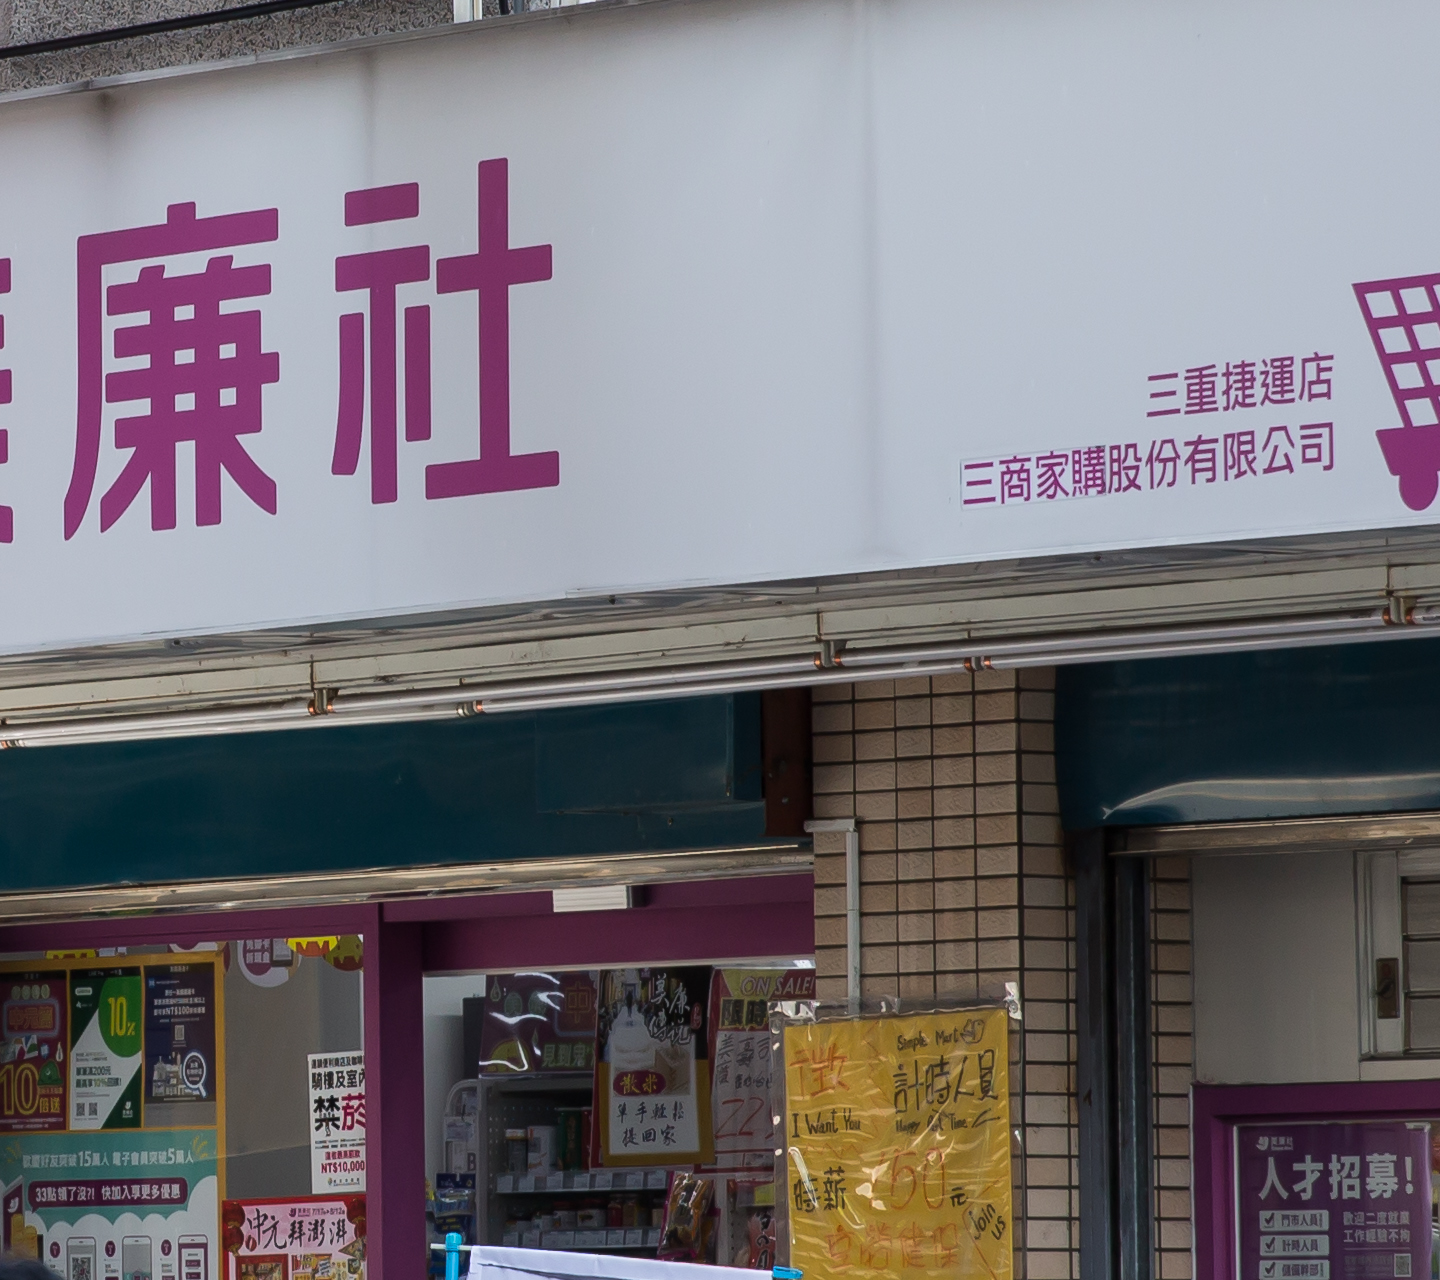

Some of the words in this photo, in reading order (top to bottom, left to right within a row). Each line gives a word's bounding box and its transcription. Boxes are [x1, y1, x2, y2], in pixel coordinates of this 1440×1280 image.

[1146, 352, 1335, 418] 三重捷運店
[962, 422, 1334, 506] 三商家購股份有限公司
[741, 976, 768, 996] ON
[773, 970, 816, 996] SALE!
[935, 1026, 960, 1046] Mart
[893, 1048, 999, 1114] 計時人員
[313, 1093, 366, 1133] 禁菸
[805, 1109, 839, 1135] Want
[842, 1108, 862, 1131] You
[320, 1161, 366, 1174] NT$10,000
[1258, 1152, 1415, 1201] 人才招募!
